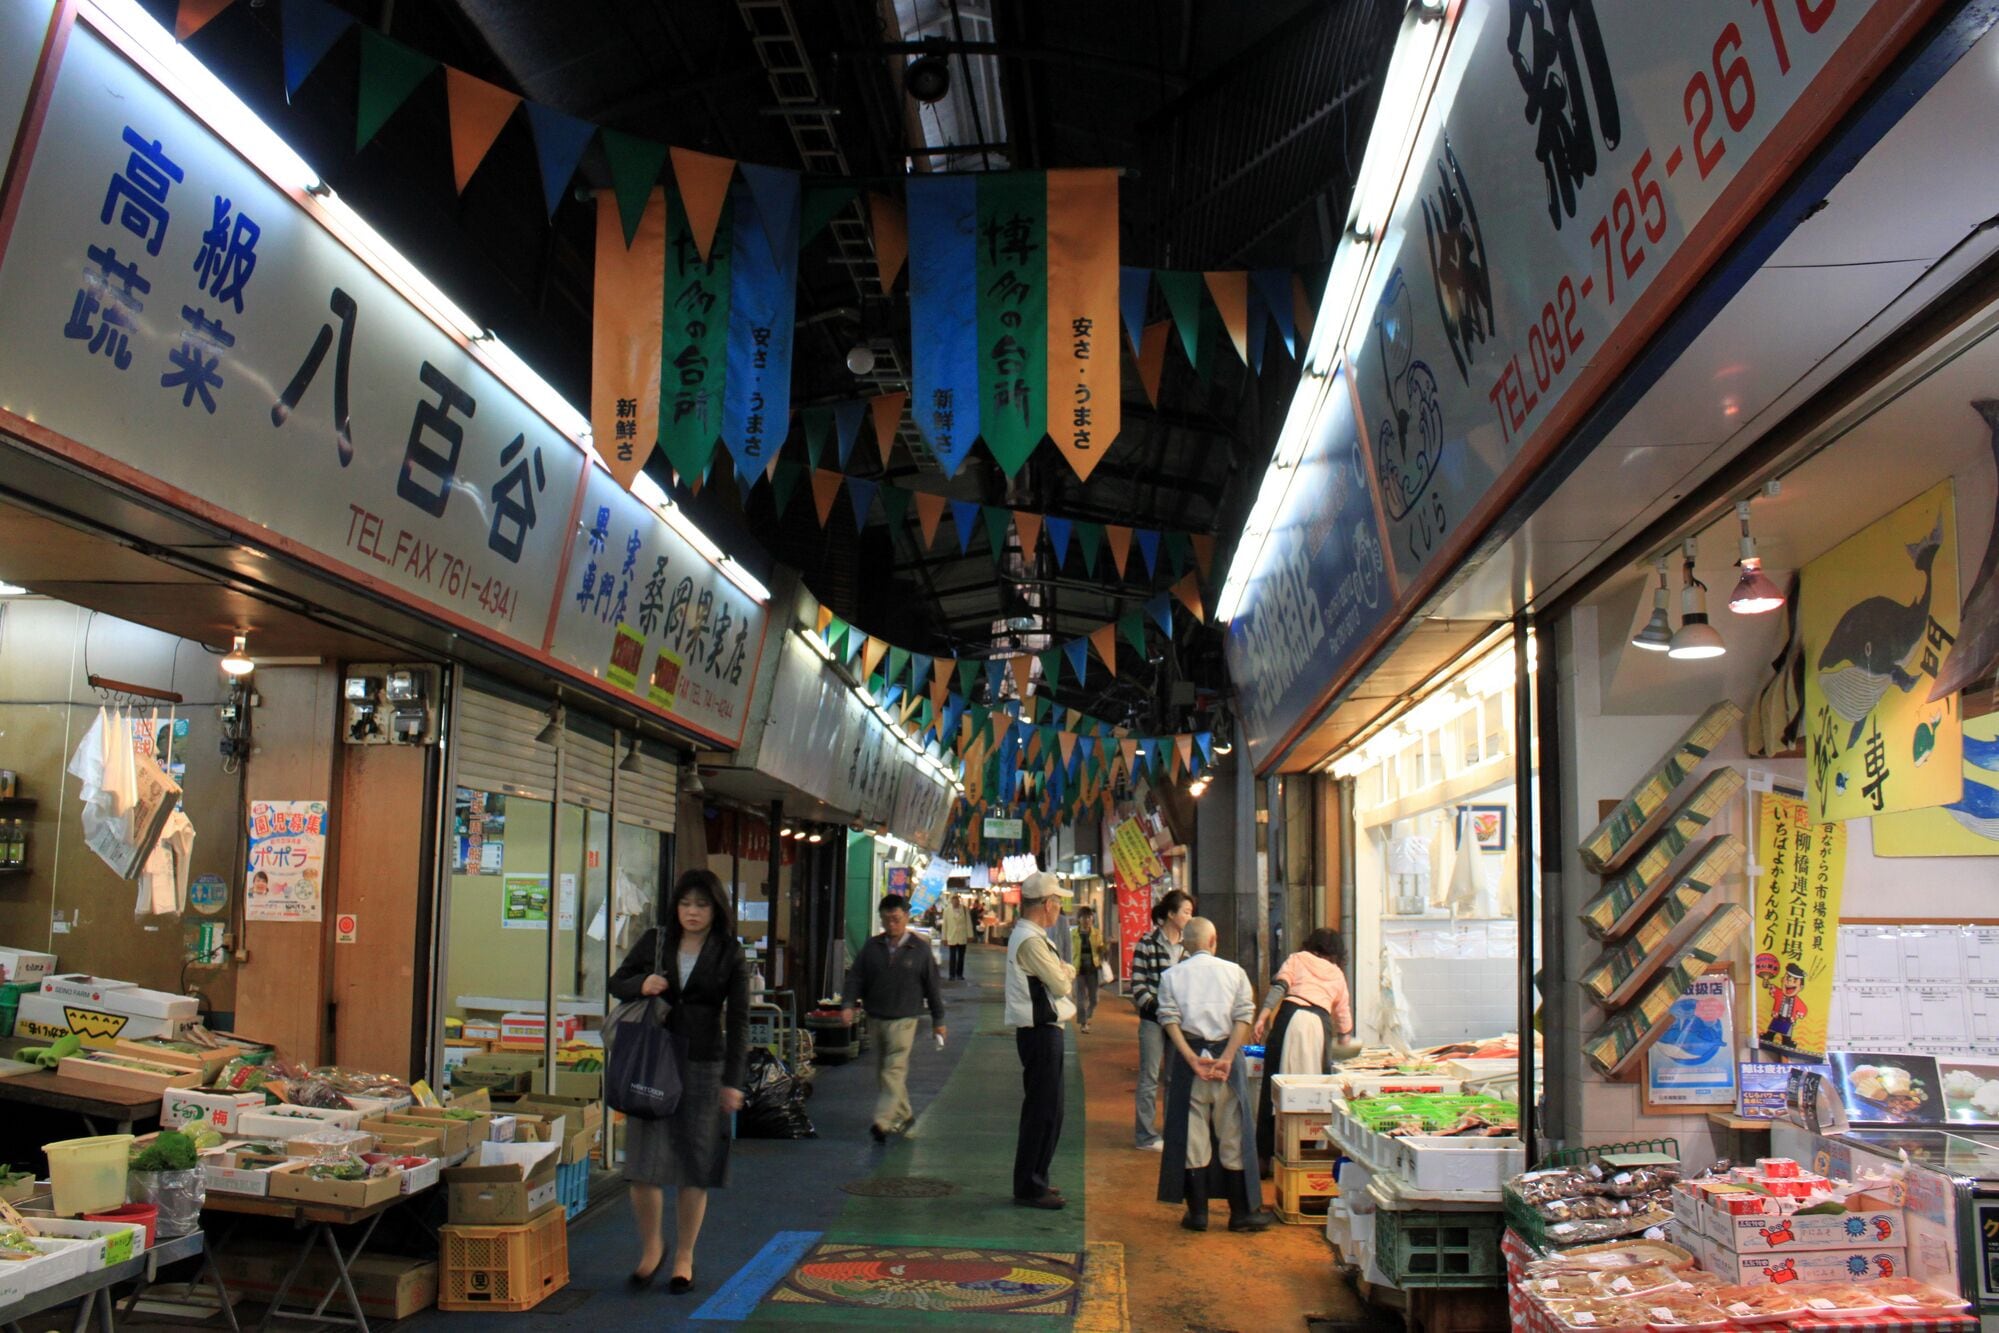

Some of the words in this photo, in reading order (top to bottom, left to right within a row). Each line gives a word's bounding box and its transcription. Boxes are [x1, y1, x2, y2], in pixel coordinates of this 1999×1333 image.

[980, 213, 1039, 430] 博多の台所
[744, 326, 771, 457] 安さ・うまさ
[1072, 316, 1093, 450] 安さ・うまさ
[271, 287, 546, 564] 八百谷
[615, 398, 637, 462] 新鮮さ
[932, 387, 954, 454] 新鮮さ
[1409, 492, 1447, 562] くじら
[439, 553, 519, 623] 761-4341
[254, 812, 322, 836] 園児募集
[254, 846, 321, 868] ポポラー
[1762, 806, 1788, 950] いちばよかもんめぐり
[1781, 830, 1812, 961] 柳橋連合市場
[212, 1109, 229, 1127] 梅
